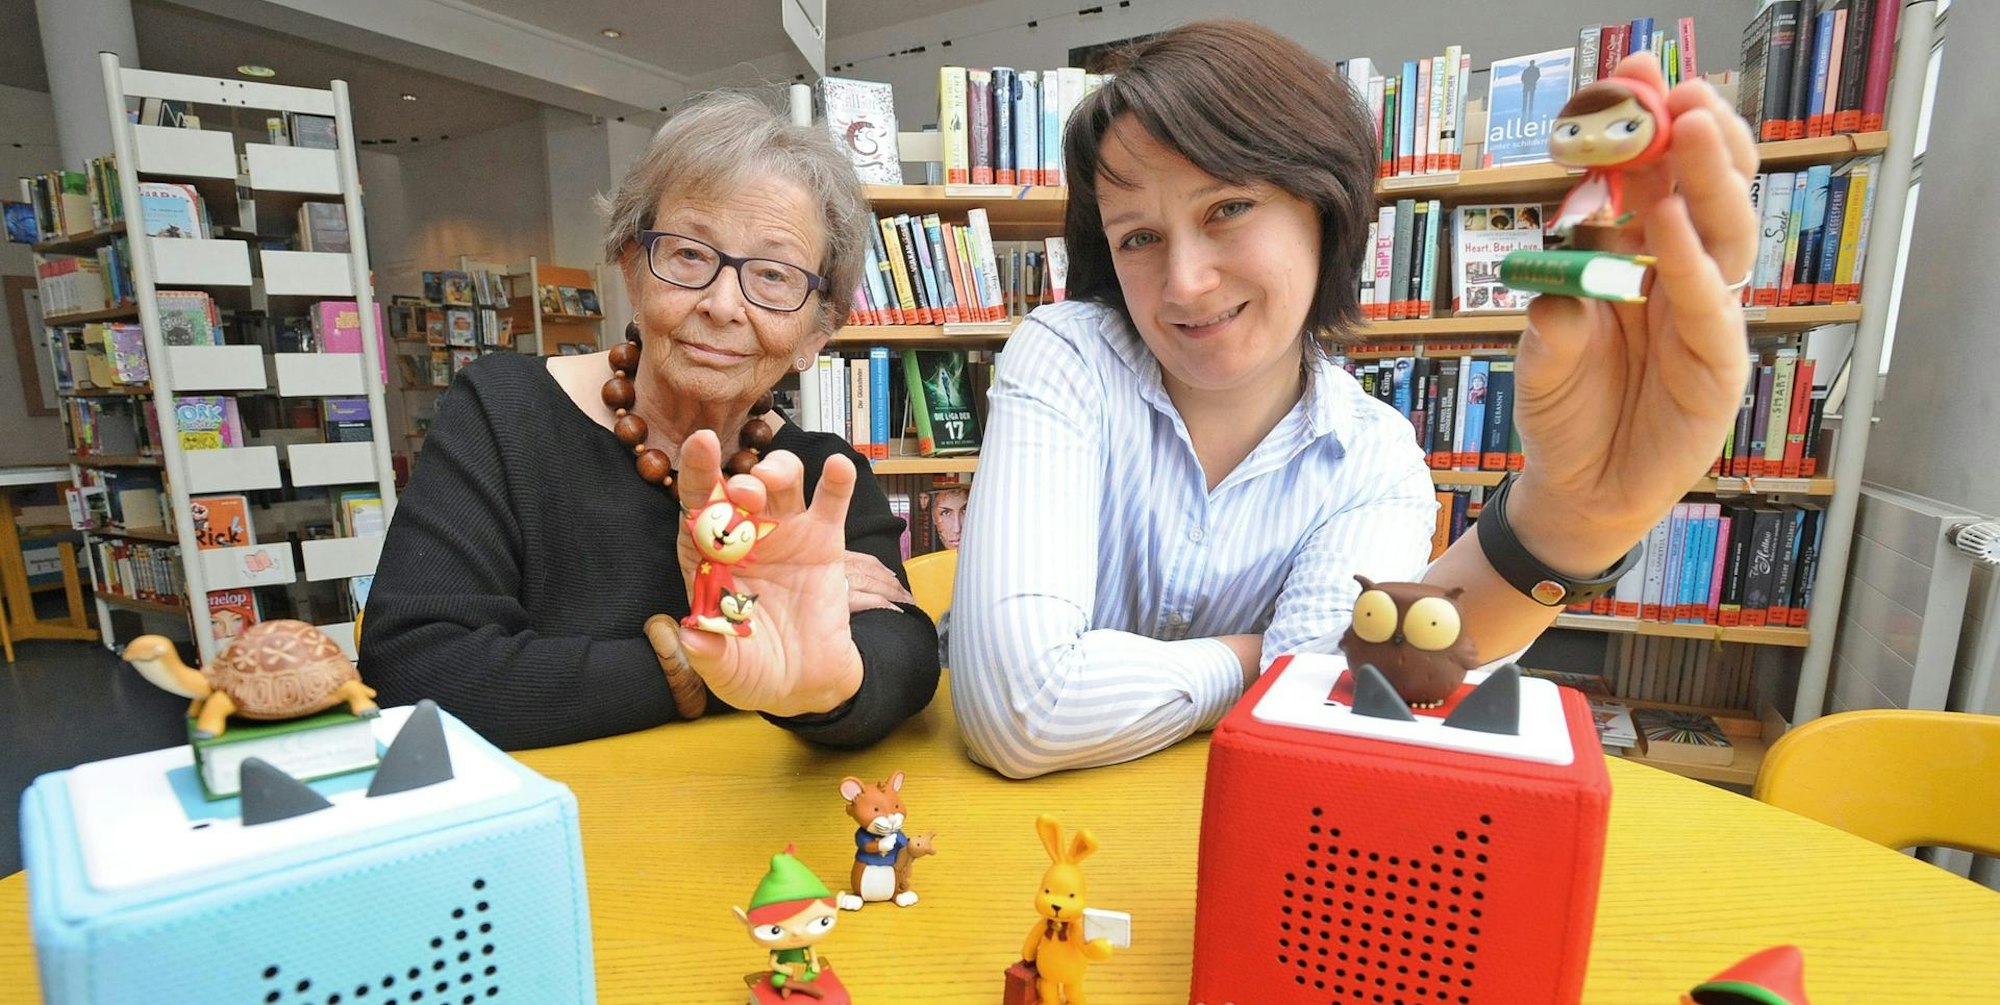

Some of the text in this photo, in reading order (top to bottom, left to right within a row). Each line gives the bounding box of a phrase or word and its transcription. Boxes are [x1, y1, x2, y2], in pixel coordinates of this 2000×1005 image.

[1464, 242, 1492, 253] Heart.
[1518, 241, 1541, 251] Love.
[1376, 235, 1393, 279] SIMPEL
[1381, 371, 1392, 396] Camp
[175, 403, 222, 422] ORK
[1495, 391, 1504, 425] GEBANNT
[945, 421, 964, 440] 17
[207, 592, 247, 606] nelop
